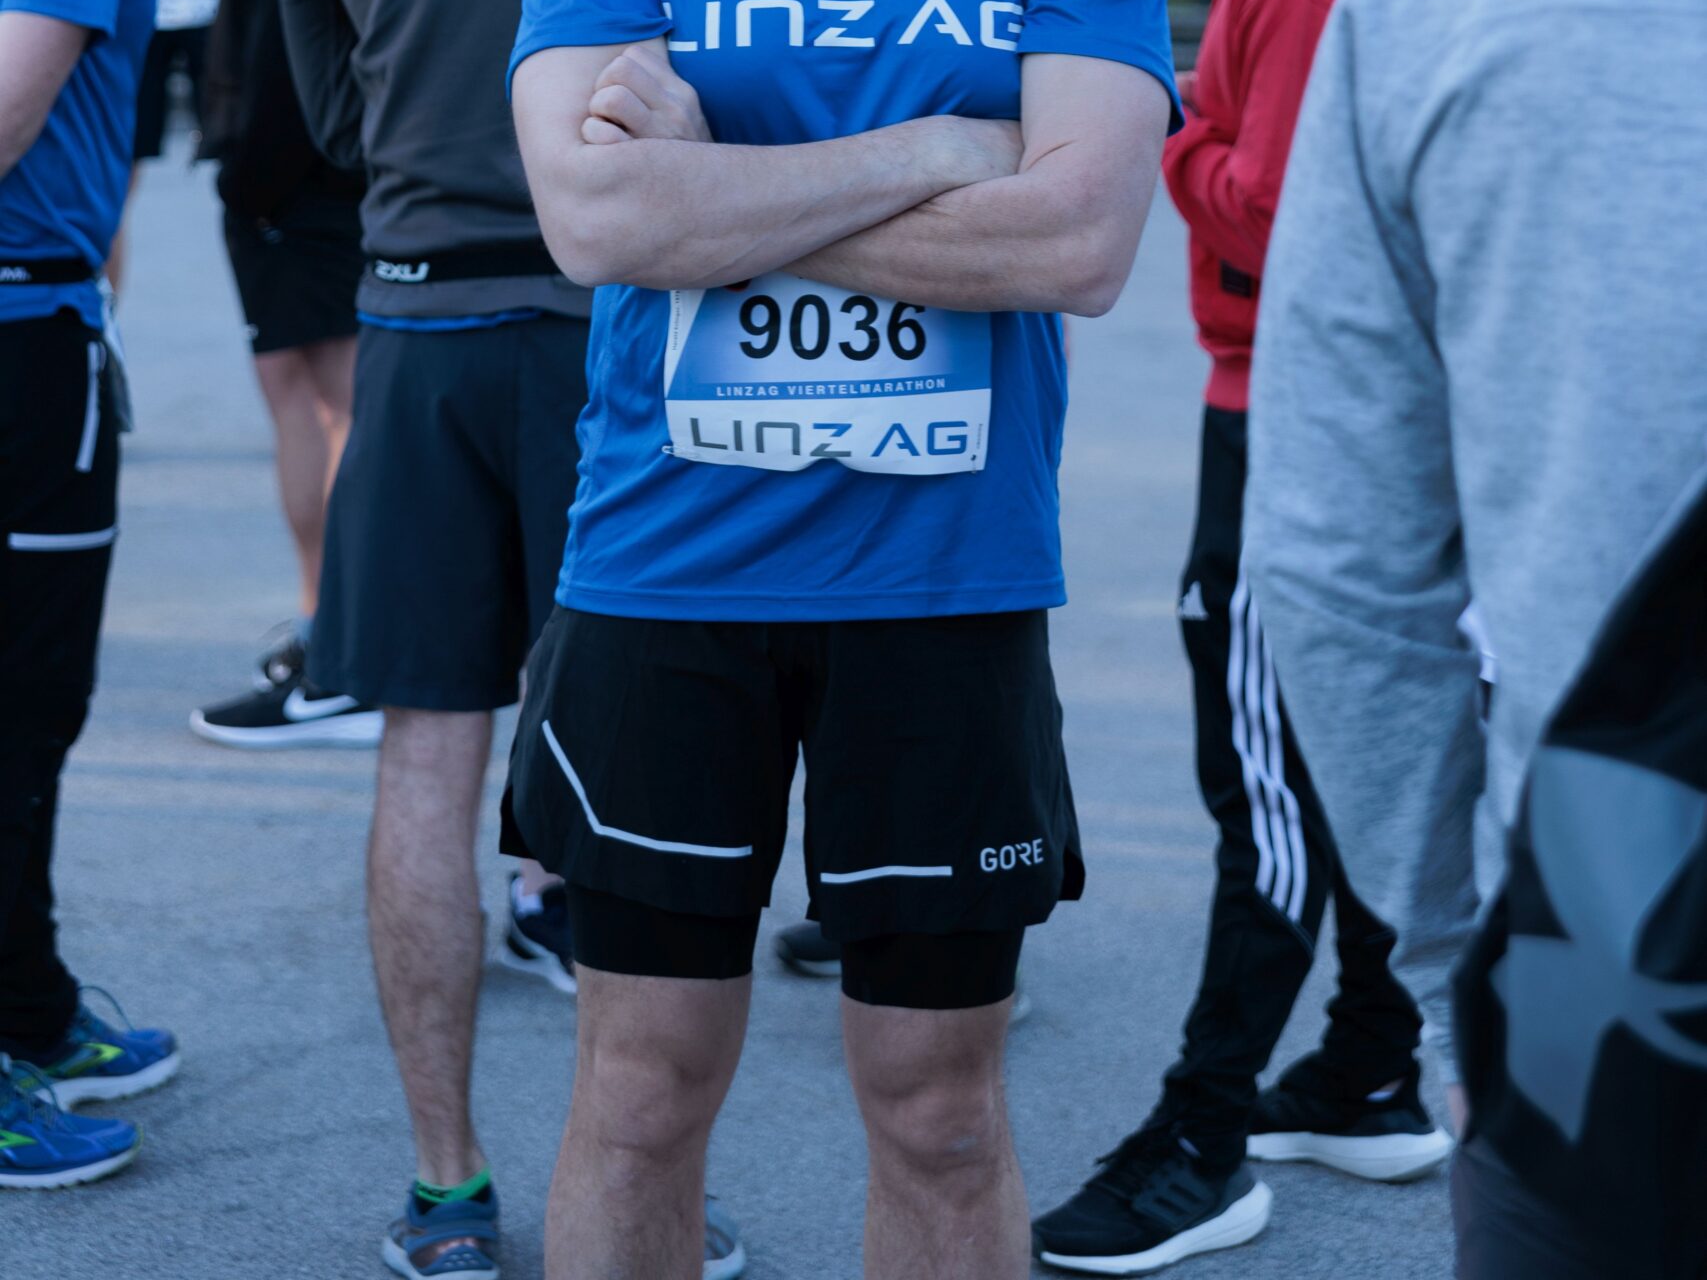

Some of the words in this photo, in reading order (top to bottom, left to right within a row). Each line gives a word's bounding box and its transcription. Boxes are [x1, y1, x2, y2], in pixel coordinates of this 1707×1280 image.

[662, 0, 875, 52] LINZ
[739, 294, 926, 361] 9036
[787, 378, 946, 397] VIERTELMARATHON
[689, 418, 853, 458] LINZ
[871, 421, 969, 458] AG
[980, 838, 1044, 872] GORE
